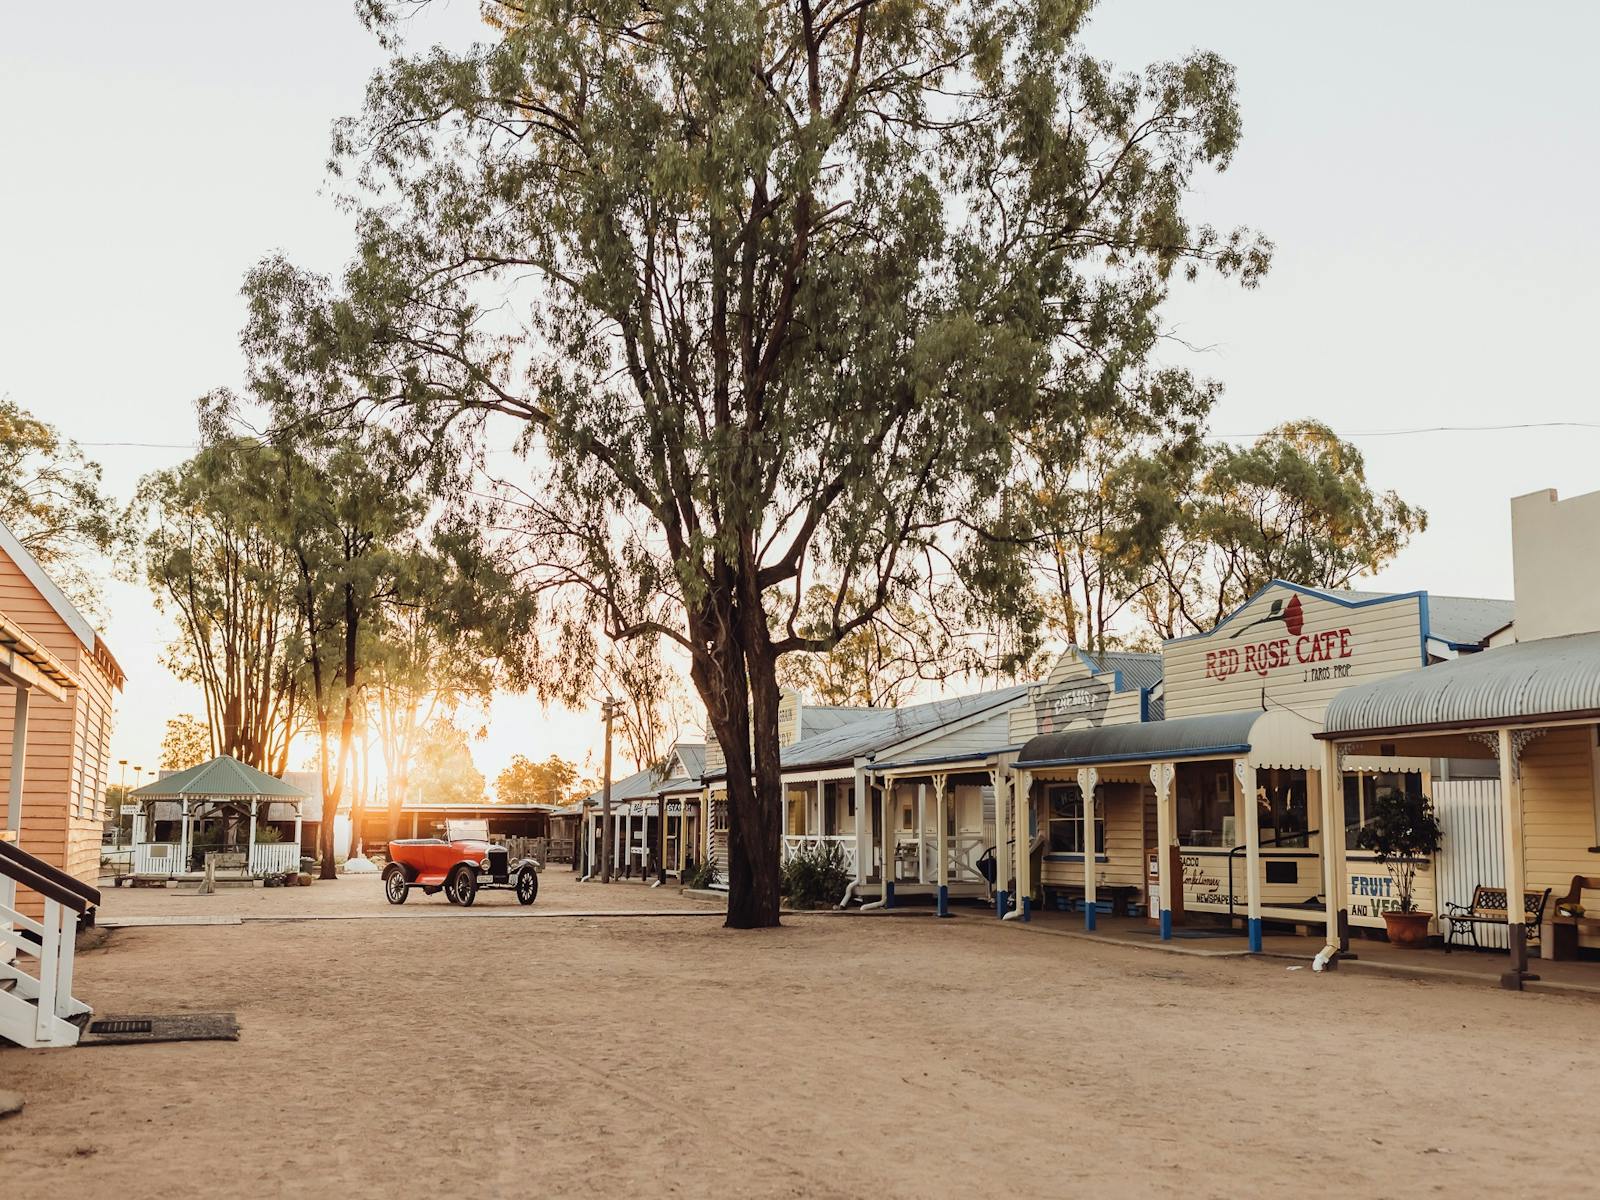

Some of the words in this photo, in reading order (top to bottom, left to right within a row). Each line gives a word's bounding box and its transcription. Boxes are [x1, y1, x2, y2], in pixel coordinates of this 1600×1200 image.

[1205, 648, 1239, 681] RED
[1244, 639, 1291, 676] ROSE
[1295, 628, 1353, 664] CAFE
[1054, 690, 1099, 715] CHEMIST
[1351, 876, 1393, 897] FRUIT
[1196, 893, 1239, 905] NEWSPAPES
[1352, 904, 1368, 917] AND
